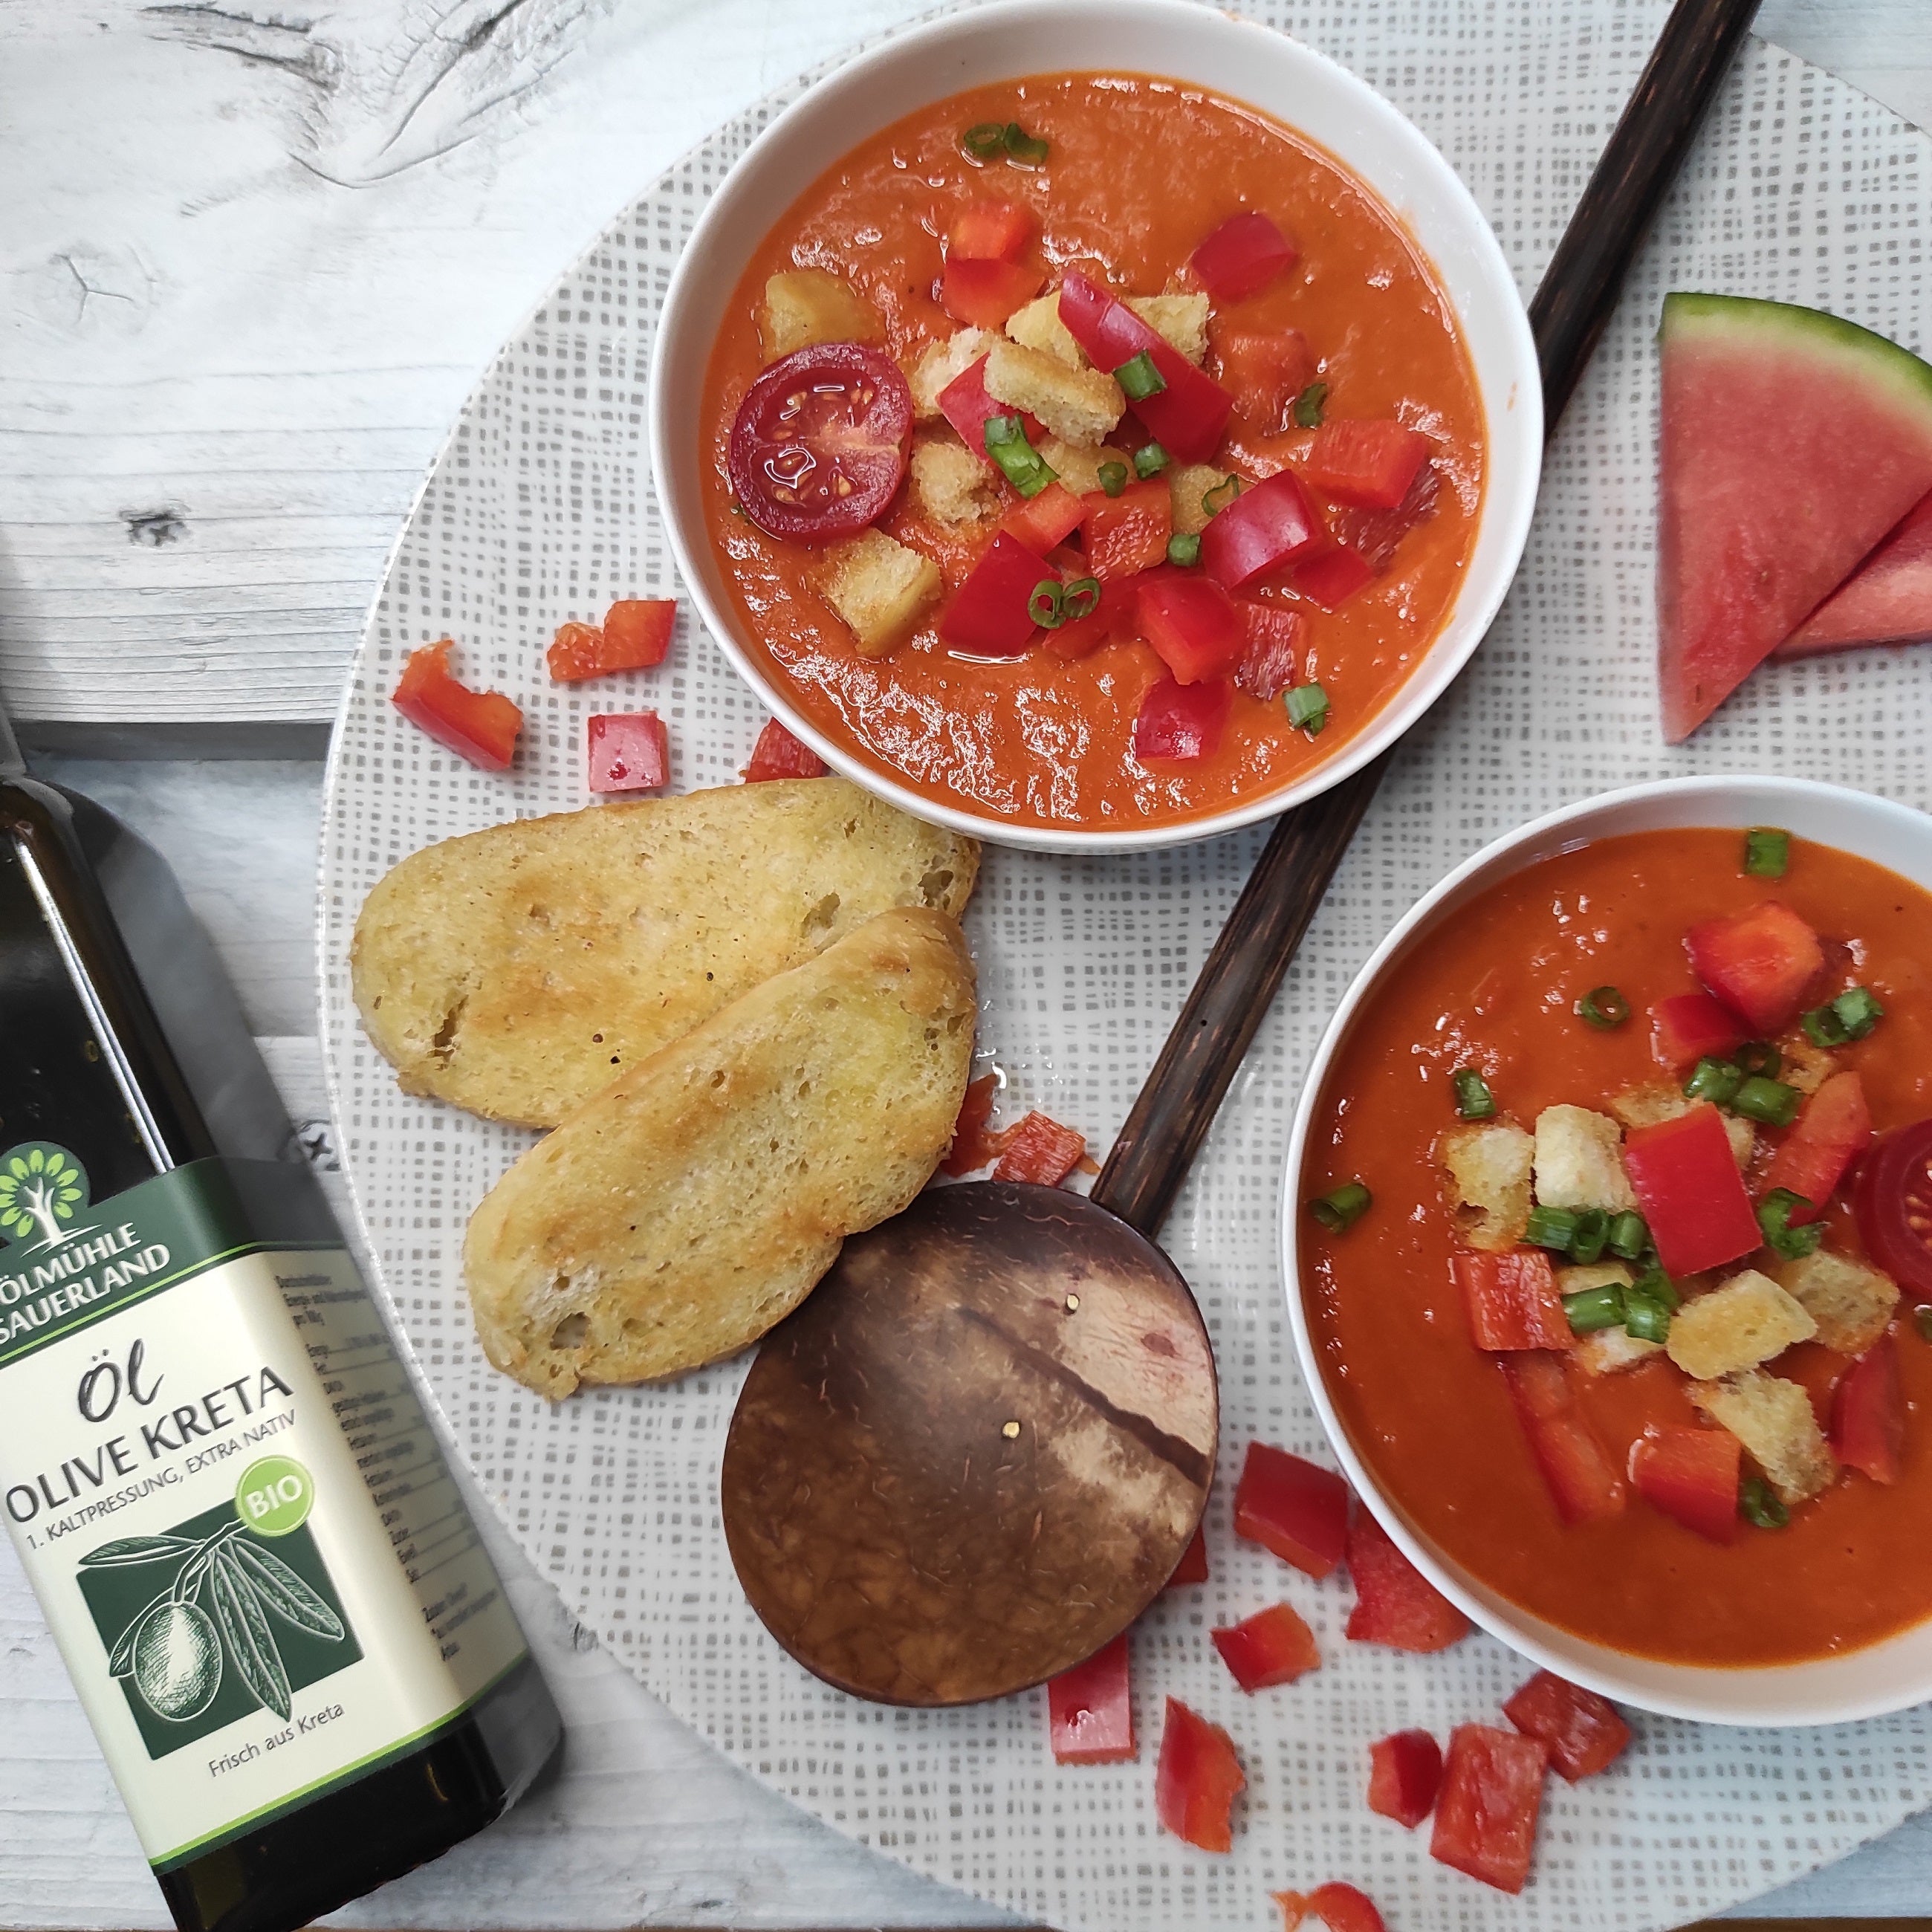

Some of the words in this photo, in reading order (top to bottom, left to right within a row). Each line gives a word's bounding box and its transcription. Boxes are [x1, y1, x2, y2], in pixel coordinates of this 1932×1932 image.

[0, 1222, 142, 1306] ÖLMÜHLE
[0, 1243, 171, 1345] SAUERLAND
[78, 1338, 165, 1423] Öl
[6, 1436, 139, 1523] OLIVE
[140, 1366, 295, 1460] KRETA
[27, 1534, 45, 1550] 1.
[46, 1467, 184, 1542] KALTPRESSUNG,
[185, 1437, 243, 1474] EXTRA
[243, 1409, 296, 1446] NATIV
[246, 1475, 304, 1520] BIO
[208, 1743, 261, 1777] Frisch
[265, 1727, 295, 1751] aus
[297, 1703, 346, 1734] Kreta
